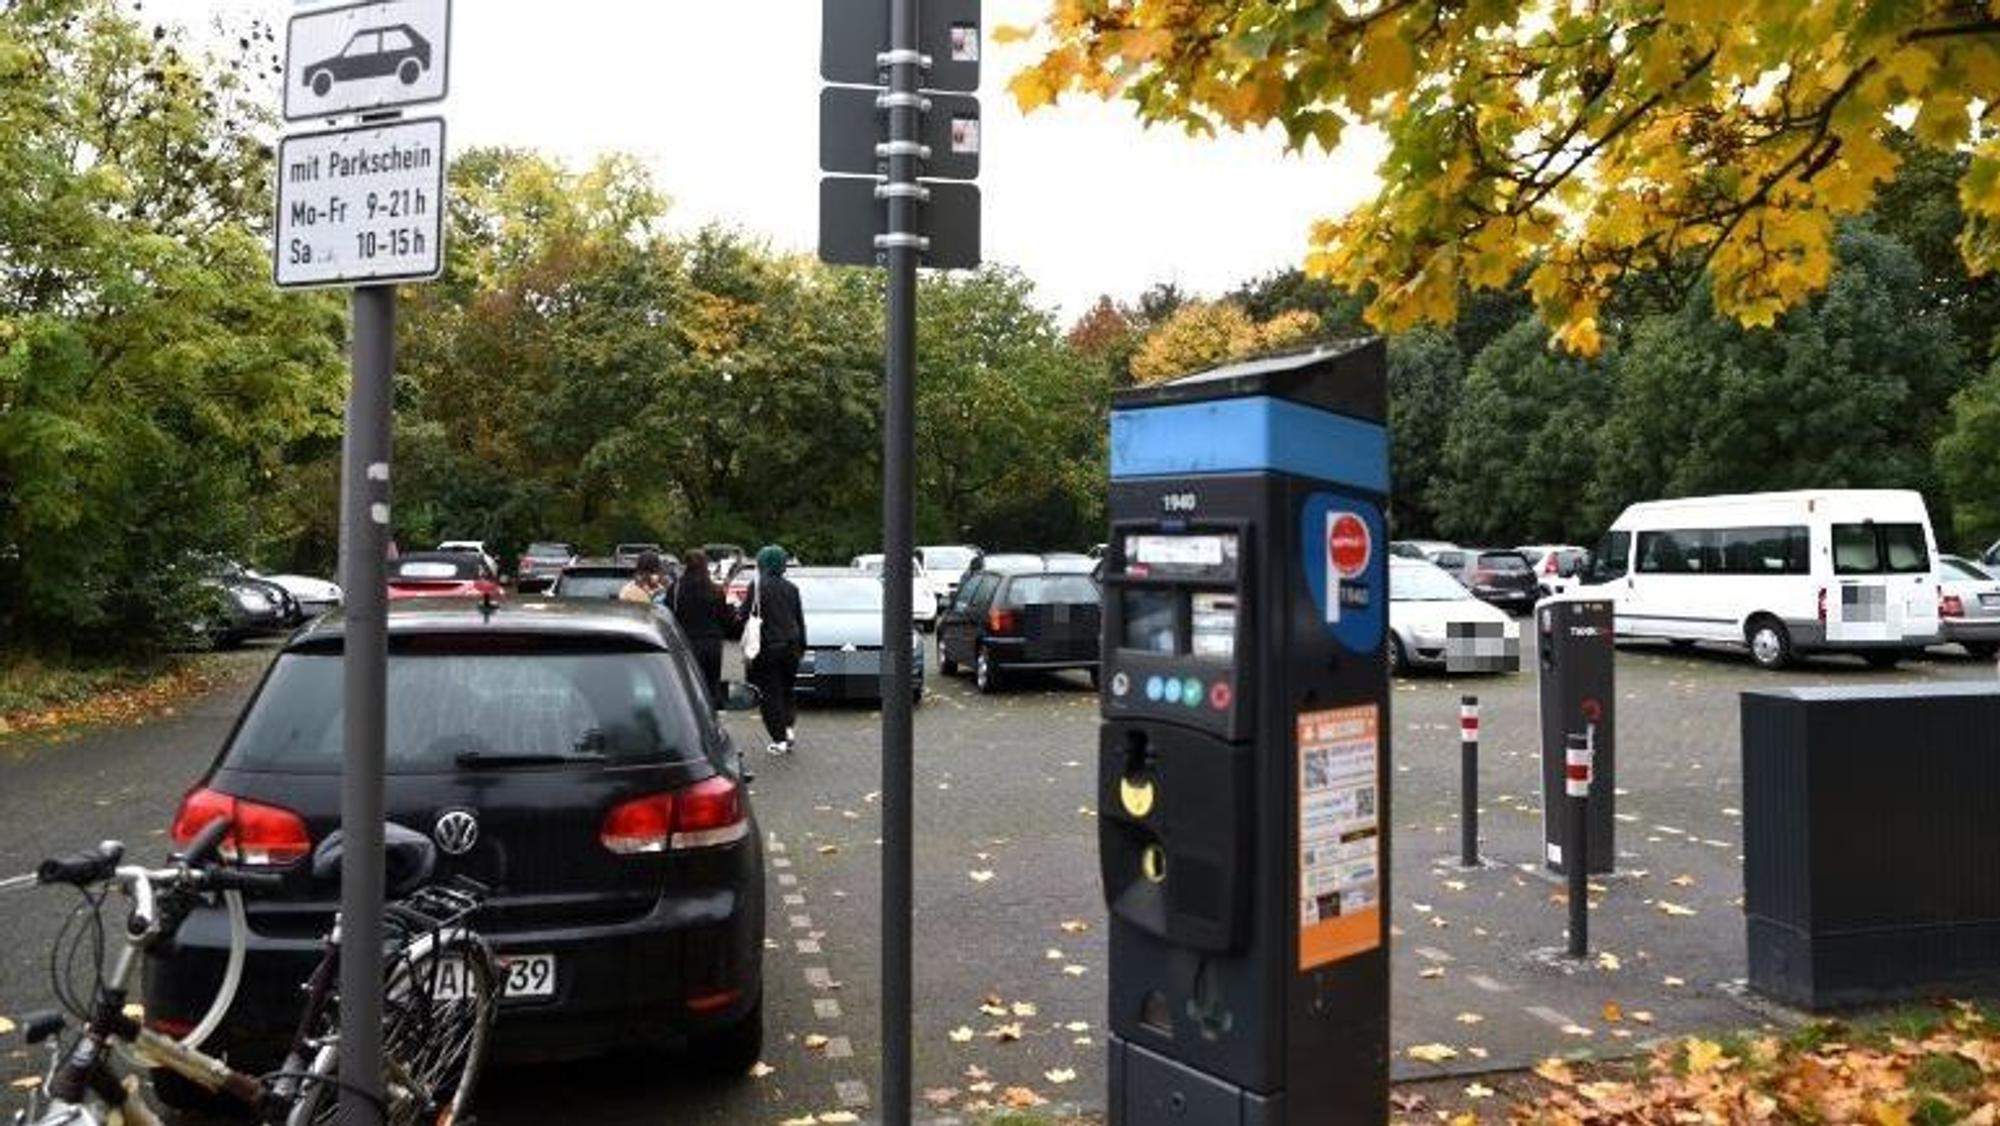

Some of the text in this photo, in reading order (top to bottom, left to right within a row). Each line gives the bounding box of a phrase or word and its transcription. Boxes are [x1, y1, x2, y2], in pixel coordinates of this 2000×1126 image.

[290, 142, 430, 182] mit Parkschein
[291, 196, 347, 227] Mo-Fr
[290, 238, 312, 264] Sa
[1164, 493, 1196, 512] 1940
[510, 959, 550, 991] 39
